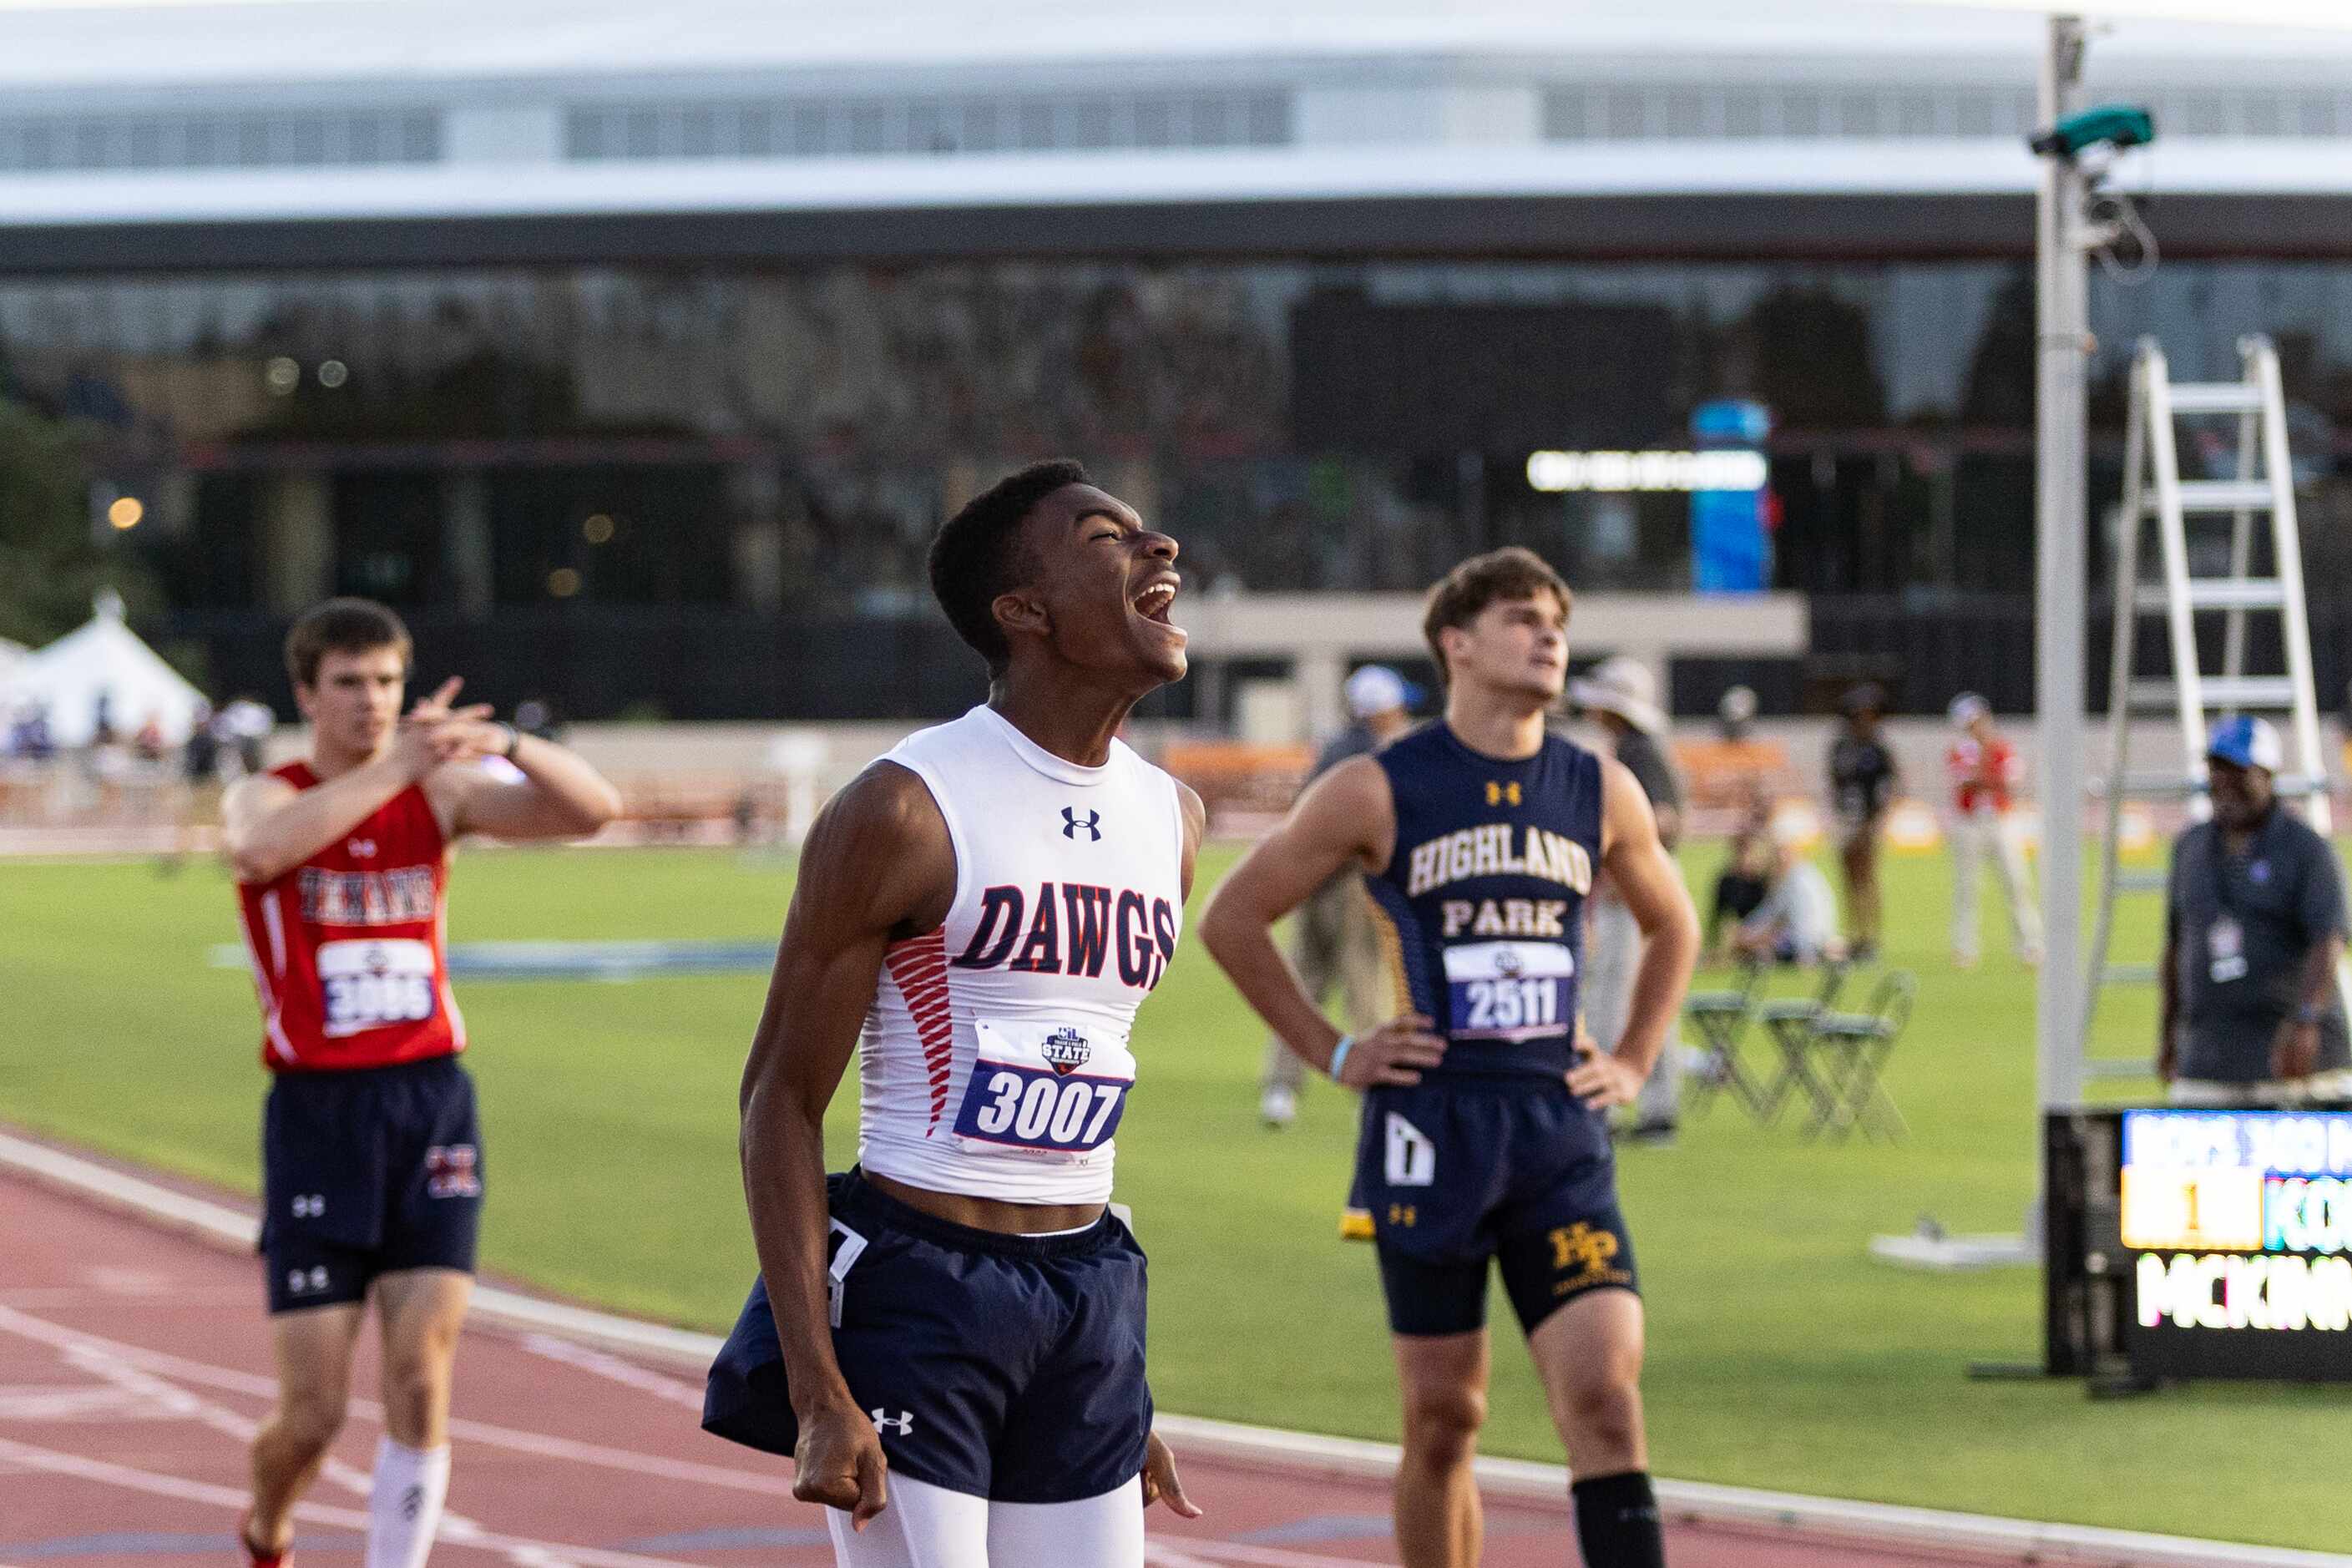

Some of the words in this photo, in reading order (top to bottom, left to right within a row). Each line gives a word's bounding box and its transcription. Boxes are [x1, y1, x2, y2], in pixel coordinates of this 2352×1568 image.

[1407, 823, 1592, 898] HIGHLAND
[948, 881, 1176, 991] DAWGS
[1442, 899, 1568, 938] PARK
[1465, 978, 1558, 1029] 2511
[1042, 1043, 1091, 1062] STATE
[976, 1071, 1124, 1146] 3007
